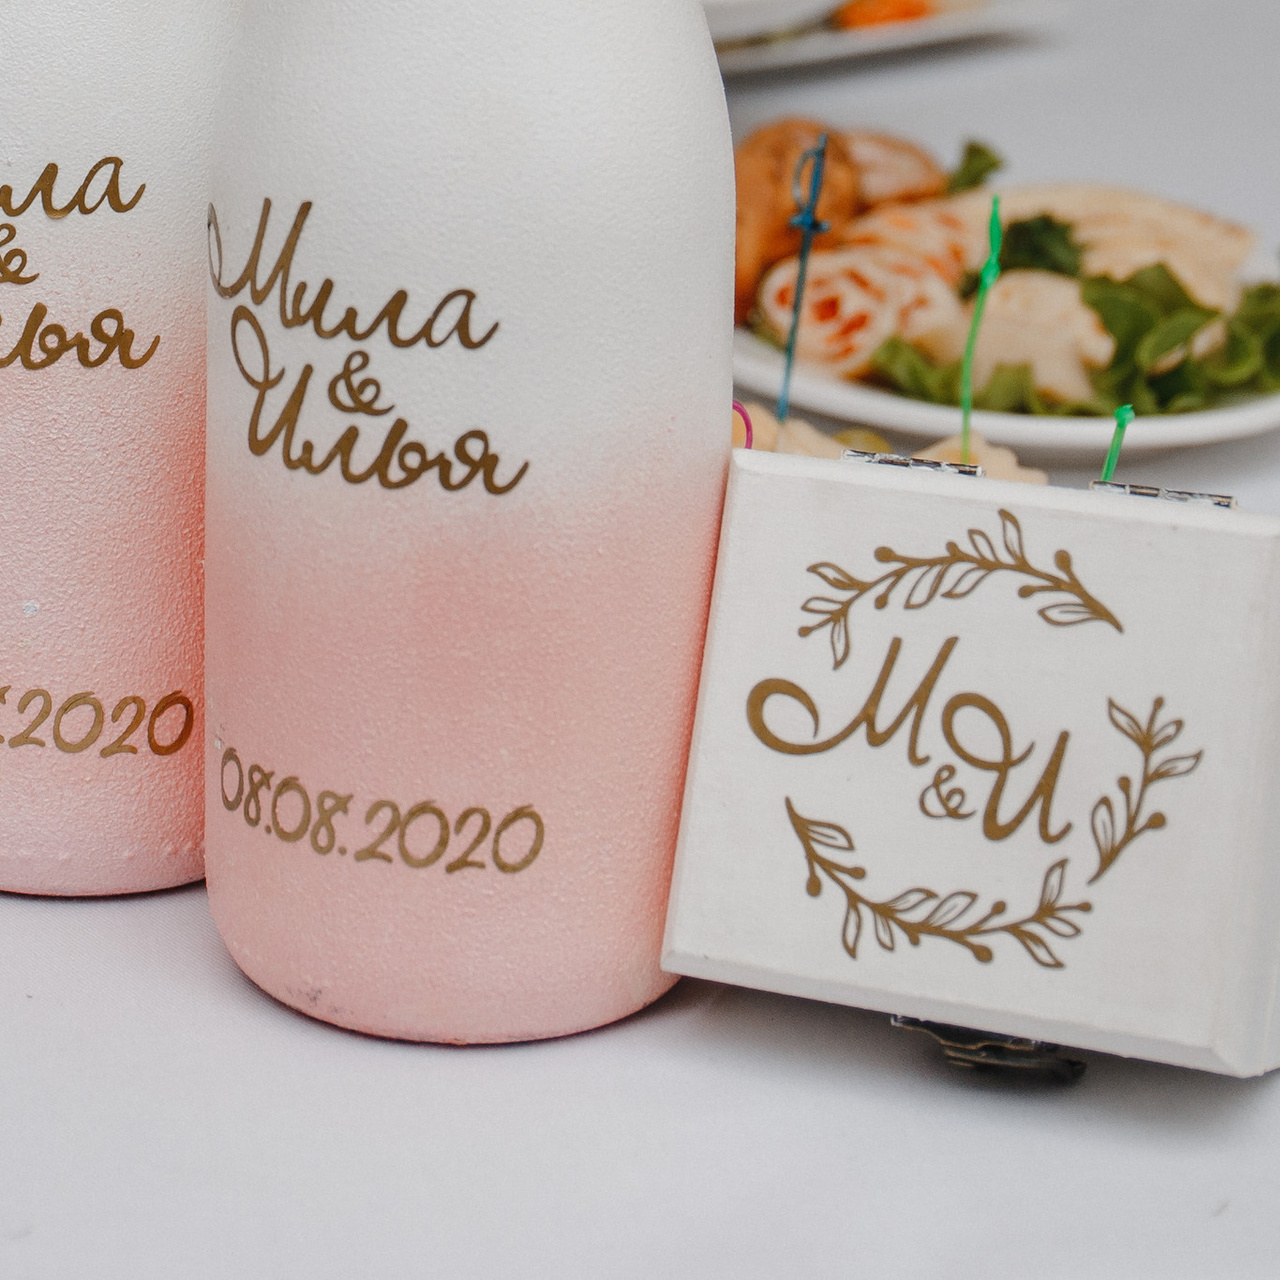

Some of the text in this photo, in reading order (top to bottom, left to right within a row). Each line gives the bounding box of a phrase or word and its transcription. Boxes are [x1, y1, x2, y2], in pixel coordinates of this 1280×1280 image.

[207, 197, 499, 349] Мила
[231, 305, 529, 495] Илья
[328, 350, 395, 416] &
[220, 747, 544, 874] 08.08.2020
[920, 765, 976, 819] &
